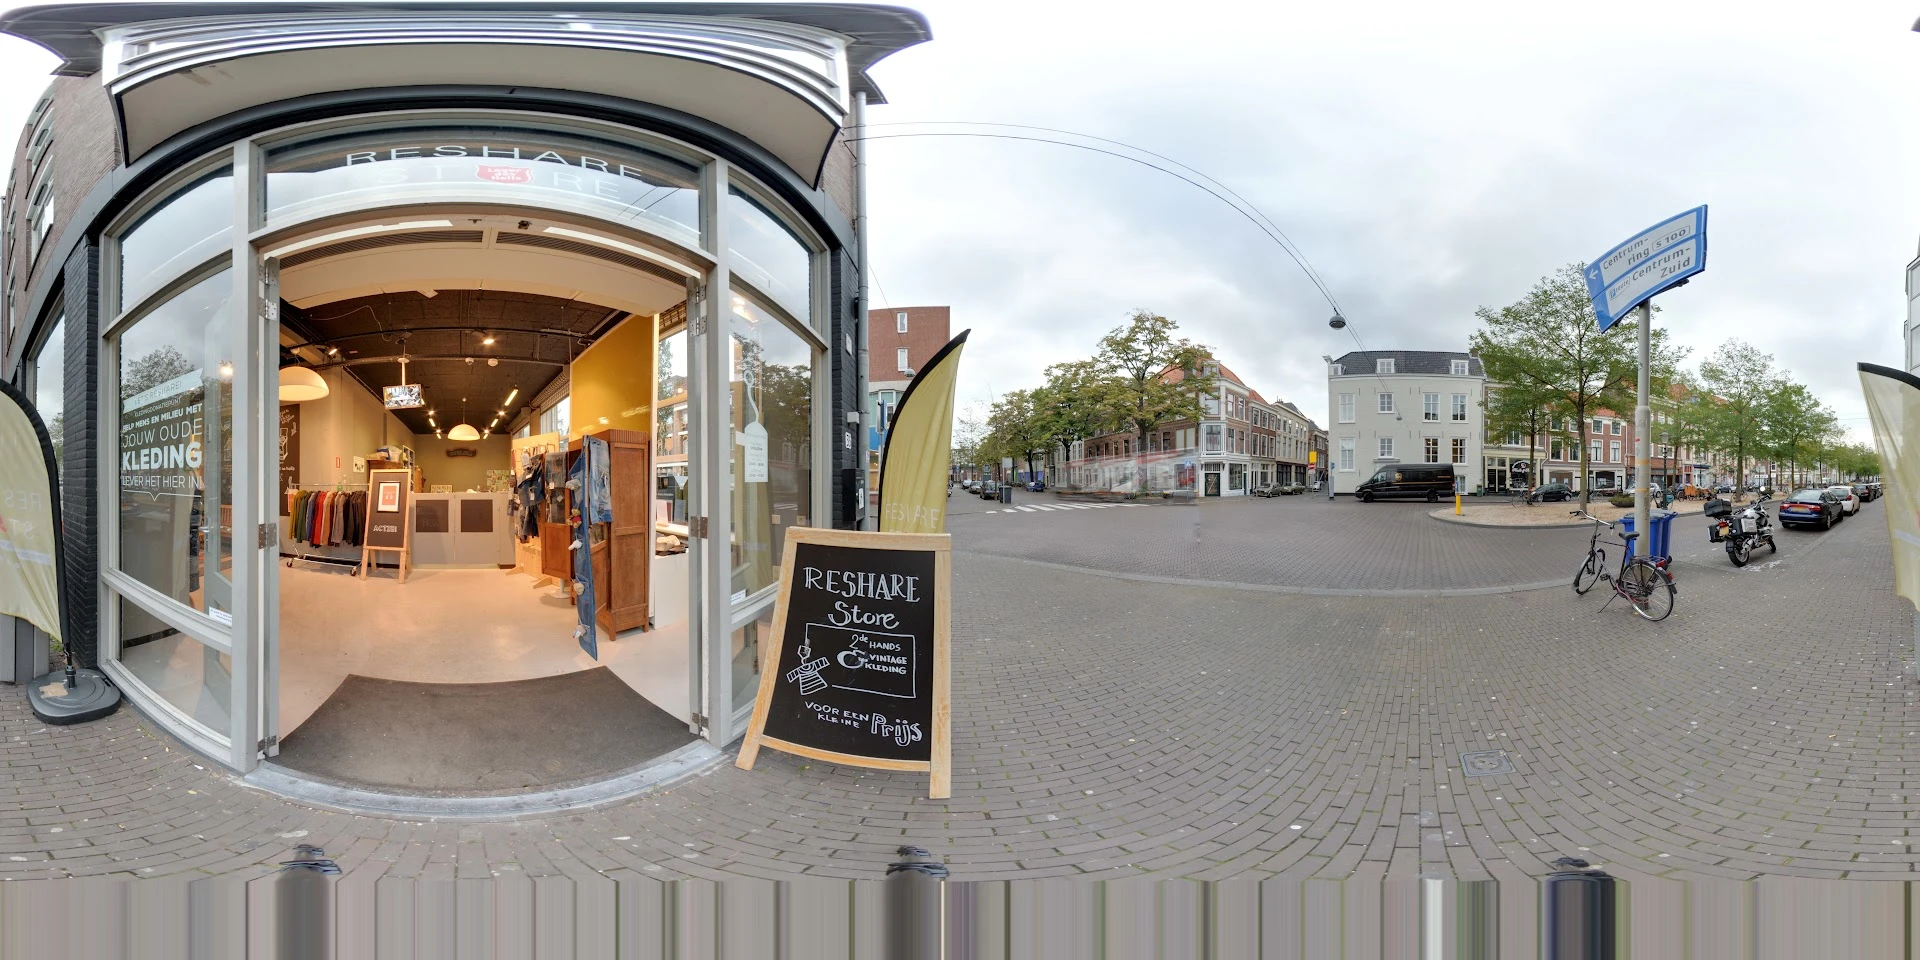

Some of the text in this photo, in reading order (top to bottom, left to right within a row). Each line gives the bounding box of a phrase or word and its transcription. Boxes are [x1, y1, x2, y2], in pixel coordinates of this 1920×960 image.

[346, 145, 643, 182] RESHARE
[1603, 238, 1649, 270] Centrum-
[1627, 247, 1650, 266] ring
[1664, 229, 1686, 243] 100
[1632, 247, 1691, 281] Centrum-
[1660, 257, 1691, 279] Zuid
[135, 418, 150, 428] MENS
[151, 414, 160, 423] EN
[160, 407, 184, 422] MILIEU
[185, 403, 203, 416] MET
[122, 418, 203, 448] JOUW OUDE
[123, 441, 202, 470] KLEDING
[122, 475, 145, 486] LEVER
[145, 476, 161, 486] HET
[162, 475, 186, 488] HIER
[803, 566, 921, 603] RESHARE
[827, 600, 900, 629] Store
[869, 640, 902, 651] HANDS
[869, 653, 908, 665] VINTAGE
[864, 662, 907, 675] KLEDING
[804, 701, 923, 747] VOOR EEN Prijs
[817, 712, 860, 729] KLEINE
